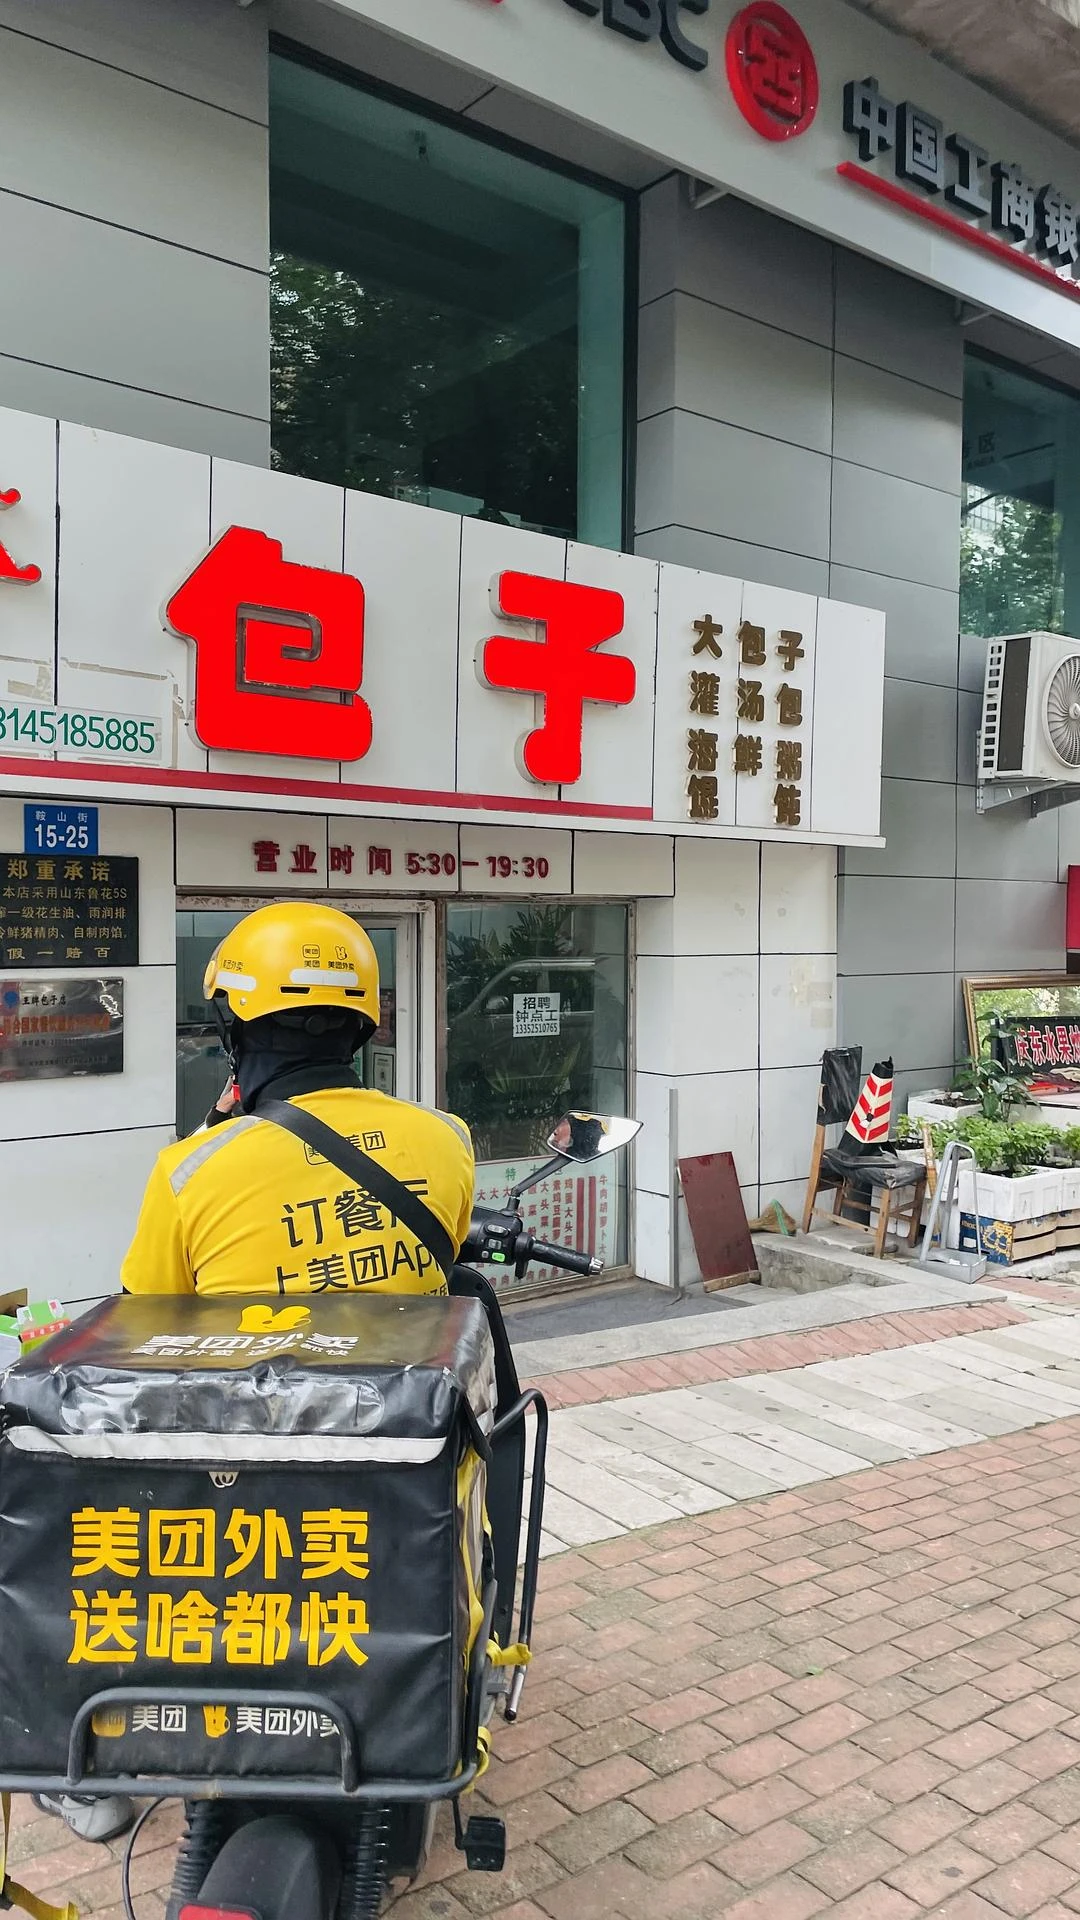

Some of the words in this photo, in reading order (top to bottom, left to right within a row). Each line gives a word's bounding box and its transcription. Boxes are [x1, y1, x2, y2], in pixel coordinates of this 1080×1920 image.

[843, 75, 1080, 268] 中国工商银
[0, 486, 636, 785] 包子
[691, 614, 805, 672] 大包子
[689, 670, 803, 727] 灌汤包
[687, 727, 802, 782] 海鲜粥
[685, 774, 802, 827] 馄饨
[35, 810, 88, 823] 鞍山街
[34, 824, 89, 849] 15-25
[7, 858, 110, 881] 郑重承诺
[252, 840, 392, 876] 营业时间
[3, 886, 127, 899] 本店采用山东鲁花5S
[6, 947, 111, 960] 假一赔百
[516, 1009, 558, 1023] 钟点工
[523, 996, 551, 1010] 招聘
[515, 1023, 558, 1034] 13352510765
[140, 1332, 359, 1349] 美团外卖
[70, 1507, 370, 1580] 美团外卖
[67, 1589, 370, 1666] 送啥都快
[131, 1705, 187, 1732] 美团
